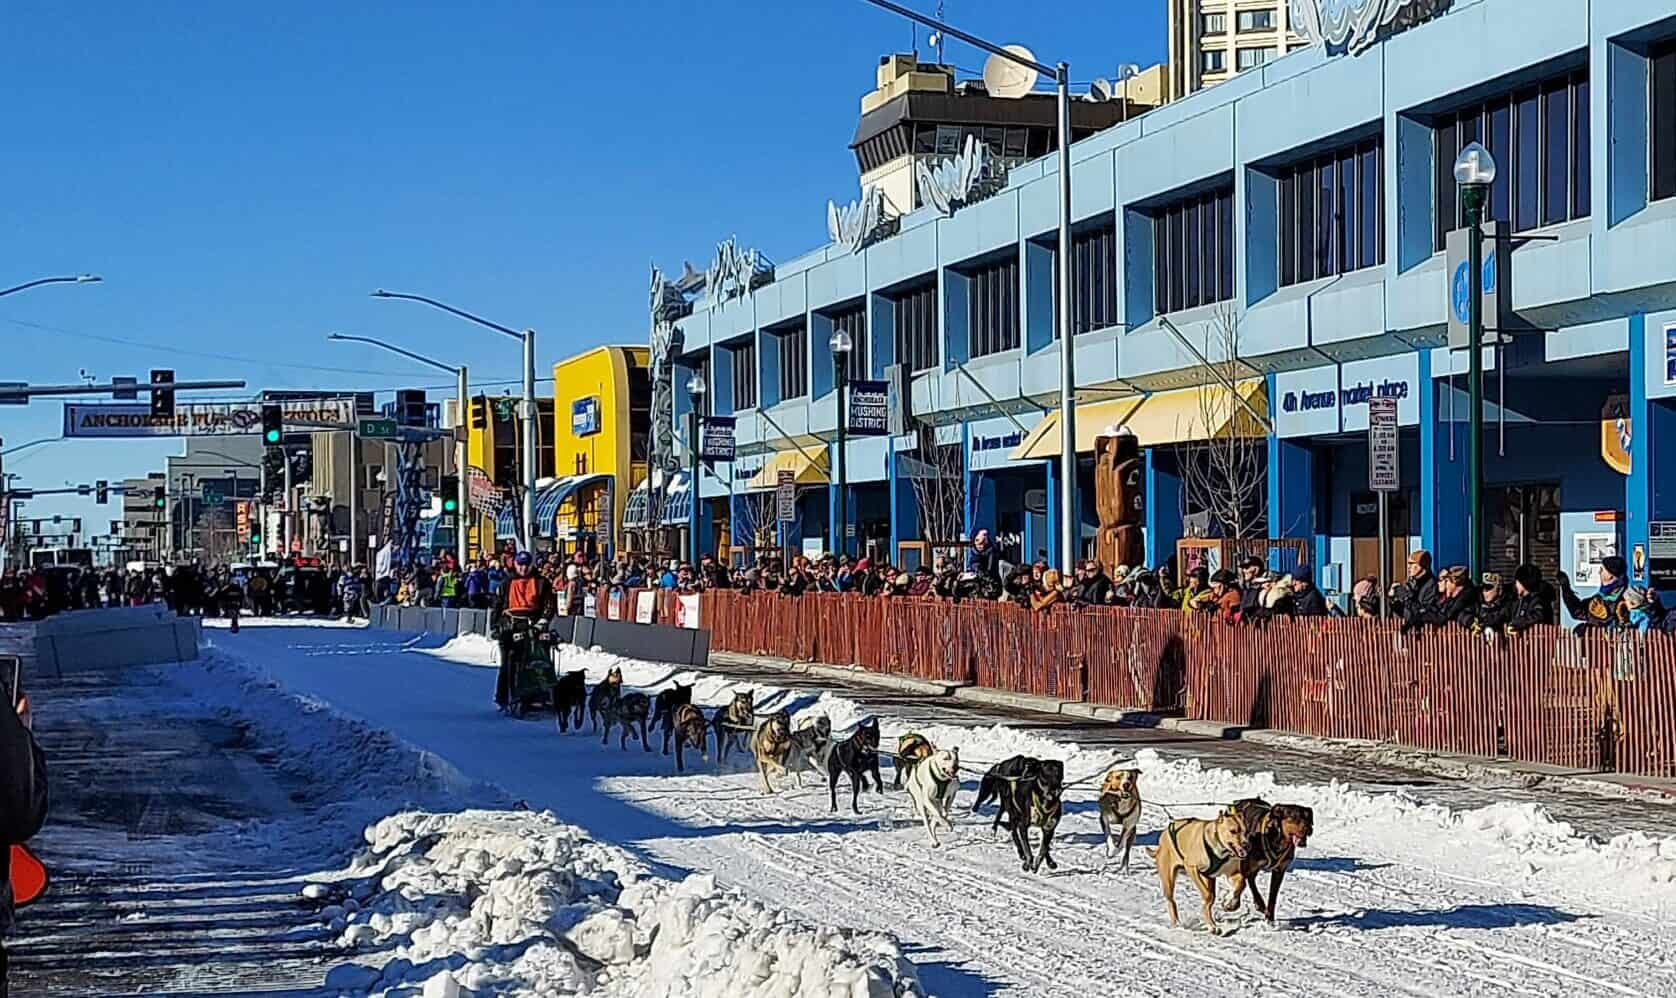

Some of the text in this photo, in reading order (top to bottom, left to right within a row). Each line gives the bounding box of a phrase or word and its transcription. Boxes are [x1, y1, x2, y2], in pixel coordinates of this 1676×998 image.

[1283, 391, 1298, 412] 4th
[1300, 390, 1336, 411] Avenue
[1377, 379, 1408, 400] place
[850, 406, 887, 417] MUSHING
[367, 424, 375, 433] D
[850, 417, 886, 429] DISTRICT
